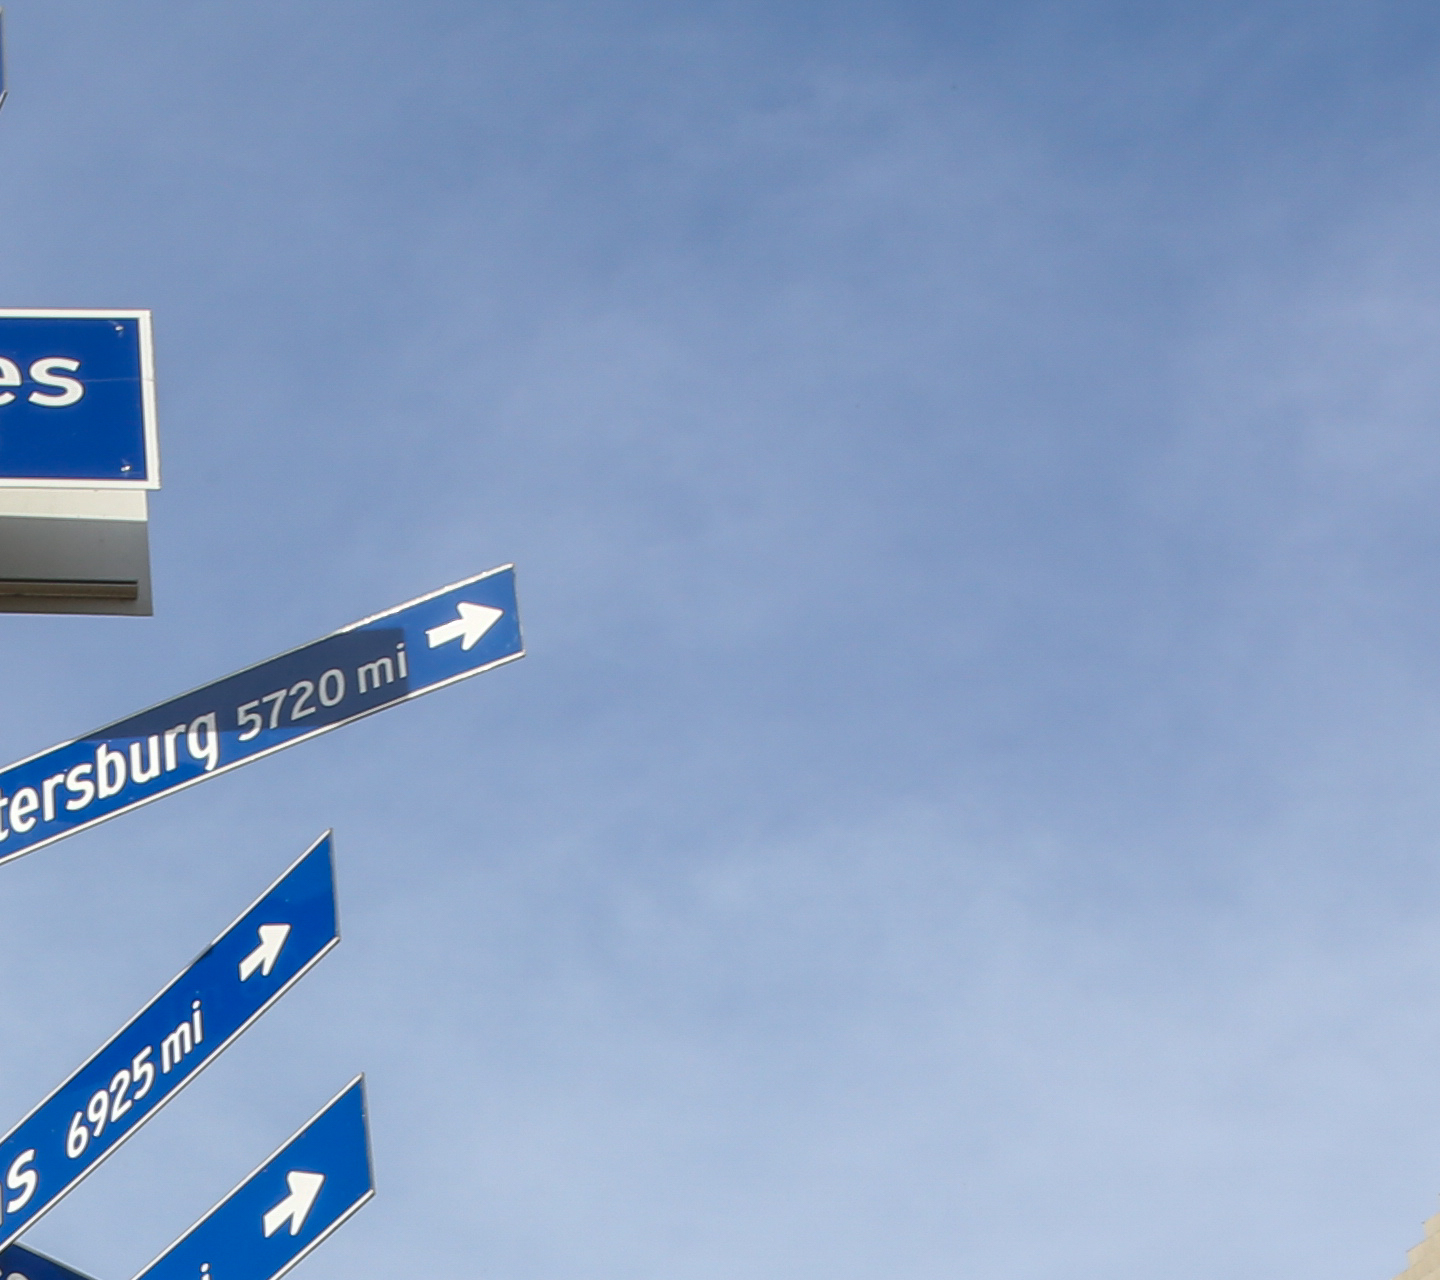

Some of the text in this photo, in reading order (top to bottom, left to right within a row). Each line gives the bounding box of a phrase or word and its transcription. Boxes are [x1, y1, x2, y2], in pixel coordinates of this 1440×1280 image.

[236, 668, 346, 743] 5720
[357, 643, 410, 698] mi
[65, 1046, 155, 1159] 6925
[161, 1000, 203, 1074] mi
